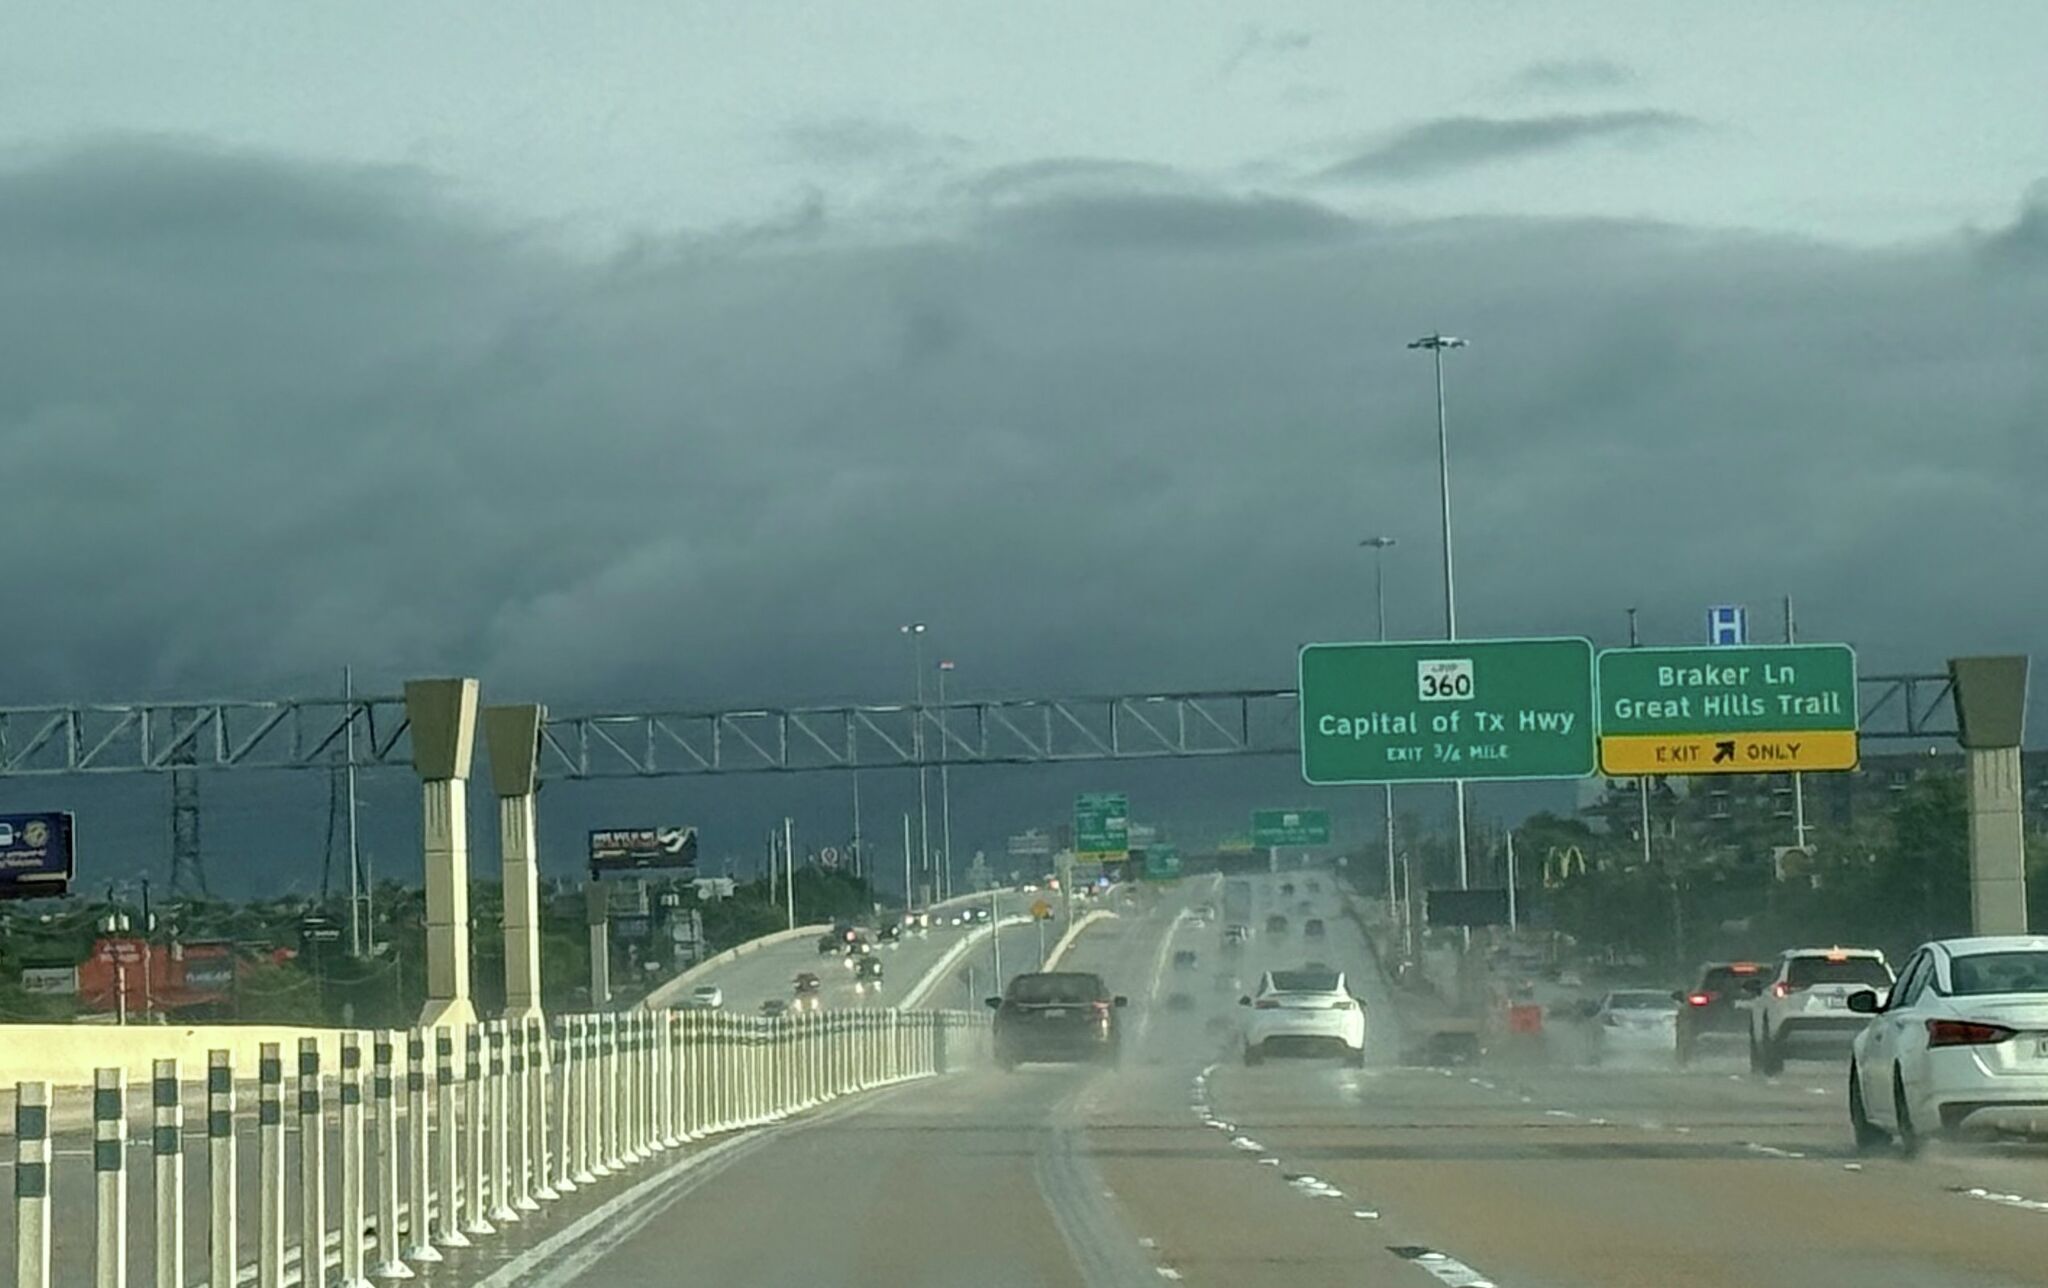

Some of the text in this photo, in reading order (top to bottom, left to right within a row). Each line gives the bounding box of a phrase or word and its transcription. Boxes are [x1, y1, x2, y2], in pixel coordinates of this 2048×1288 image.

[1713, 609, 1742, 645] H
[1422, 673, 1471, 697] 360
[1658, 664, 1795, 687] Braker Ln
[1614, 692, 1841, 719] Great Hills Trail
[1319, 710, 1575, 740] Capital of Tx Hwy
[1387, 744, 1509, 762] EXIT 3/4 MILE
[1656, 743, 1801, 763] EXIT ONLY
